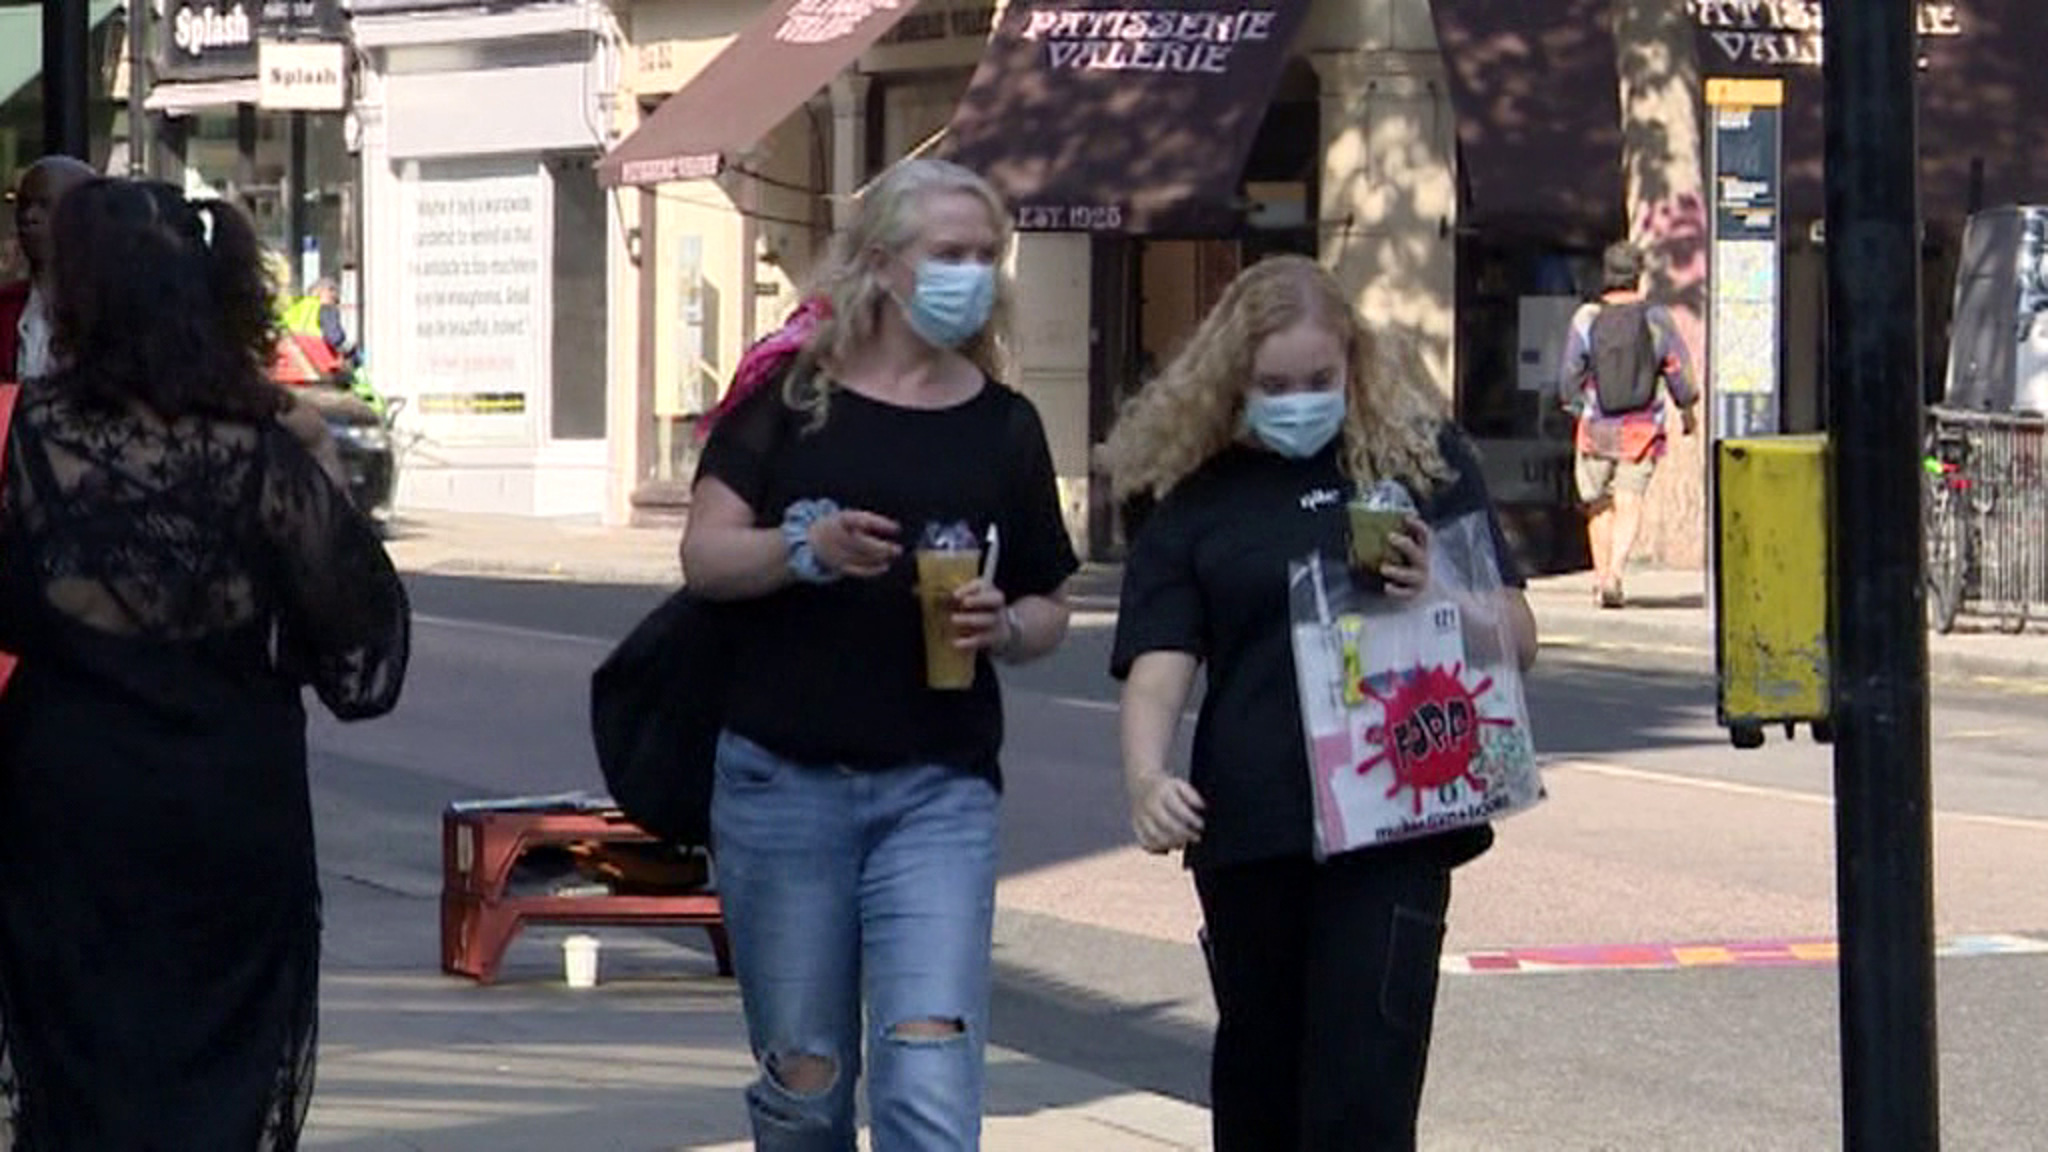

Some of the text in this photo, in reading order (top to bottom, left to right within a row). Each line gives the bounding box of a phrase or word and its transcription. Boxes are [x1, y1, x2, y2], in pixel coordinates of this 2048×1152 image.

[174, 4, 249, 54] Splash
[1022, 9, 1275, 41] PATISSERIE
[1046, 40, 1232, 72] VALERIE
[269, 67, 336, 88] Splash
